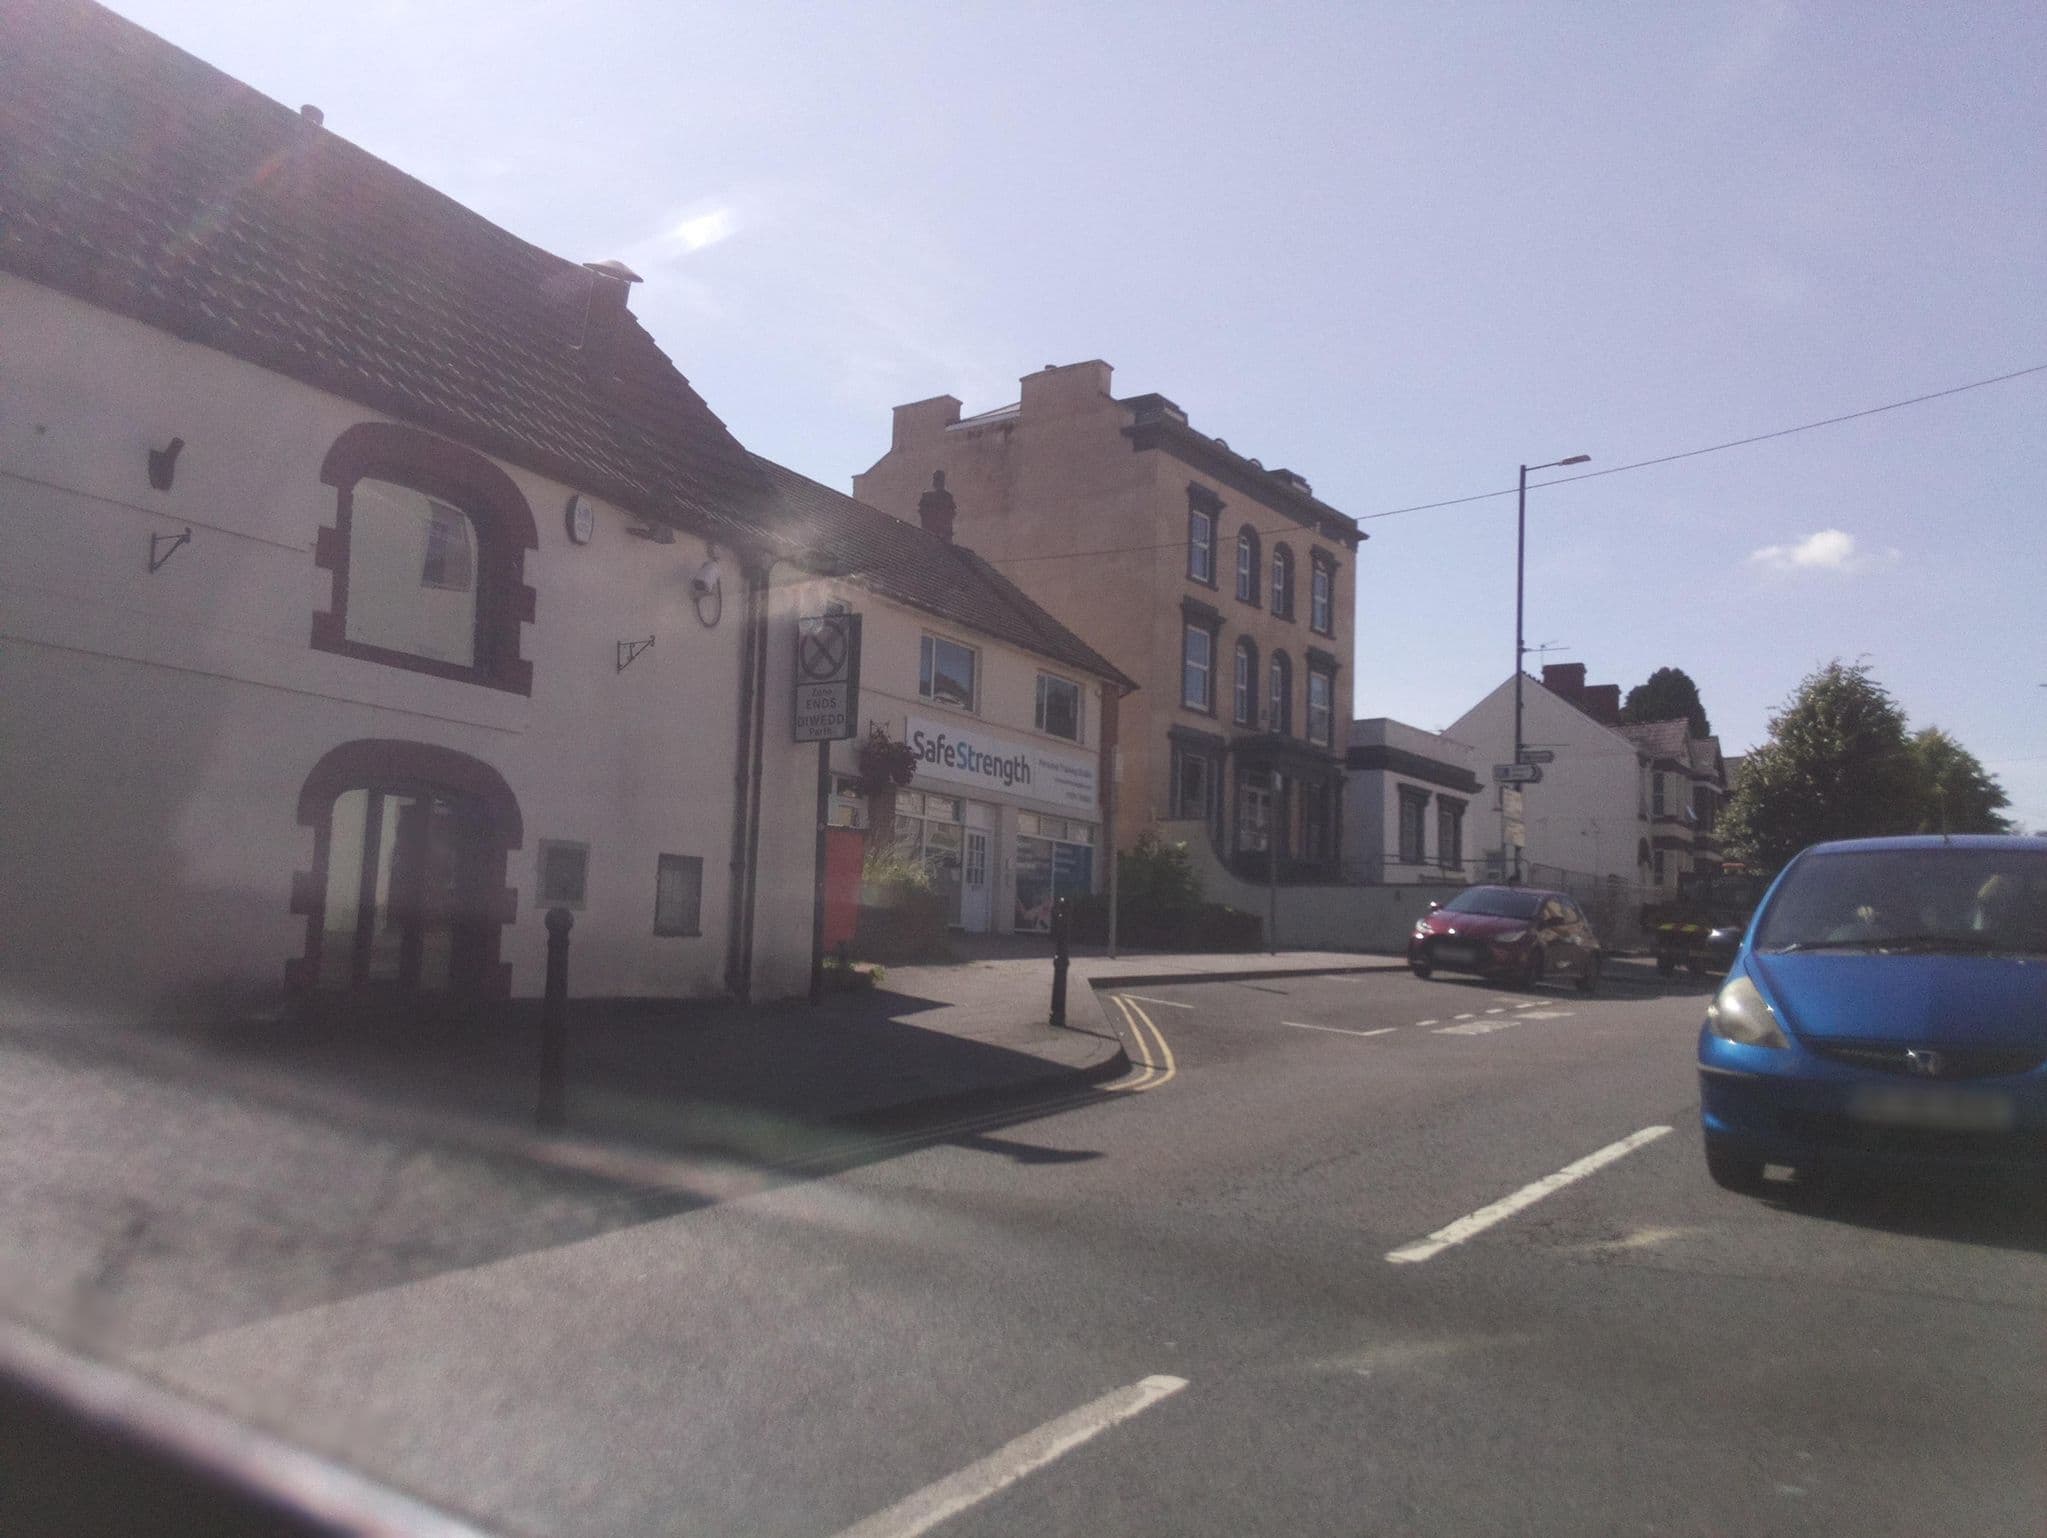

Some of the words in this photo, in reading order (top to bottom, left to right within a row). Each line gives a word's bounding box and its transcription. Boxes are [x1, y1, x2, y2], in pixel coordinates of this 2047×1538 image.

[806, 697, 836, 710] ENDS
[797, 712, 844, 727] DIWEDD
[912, 730, 1031, 786] SafeStrength
